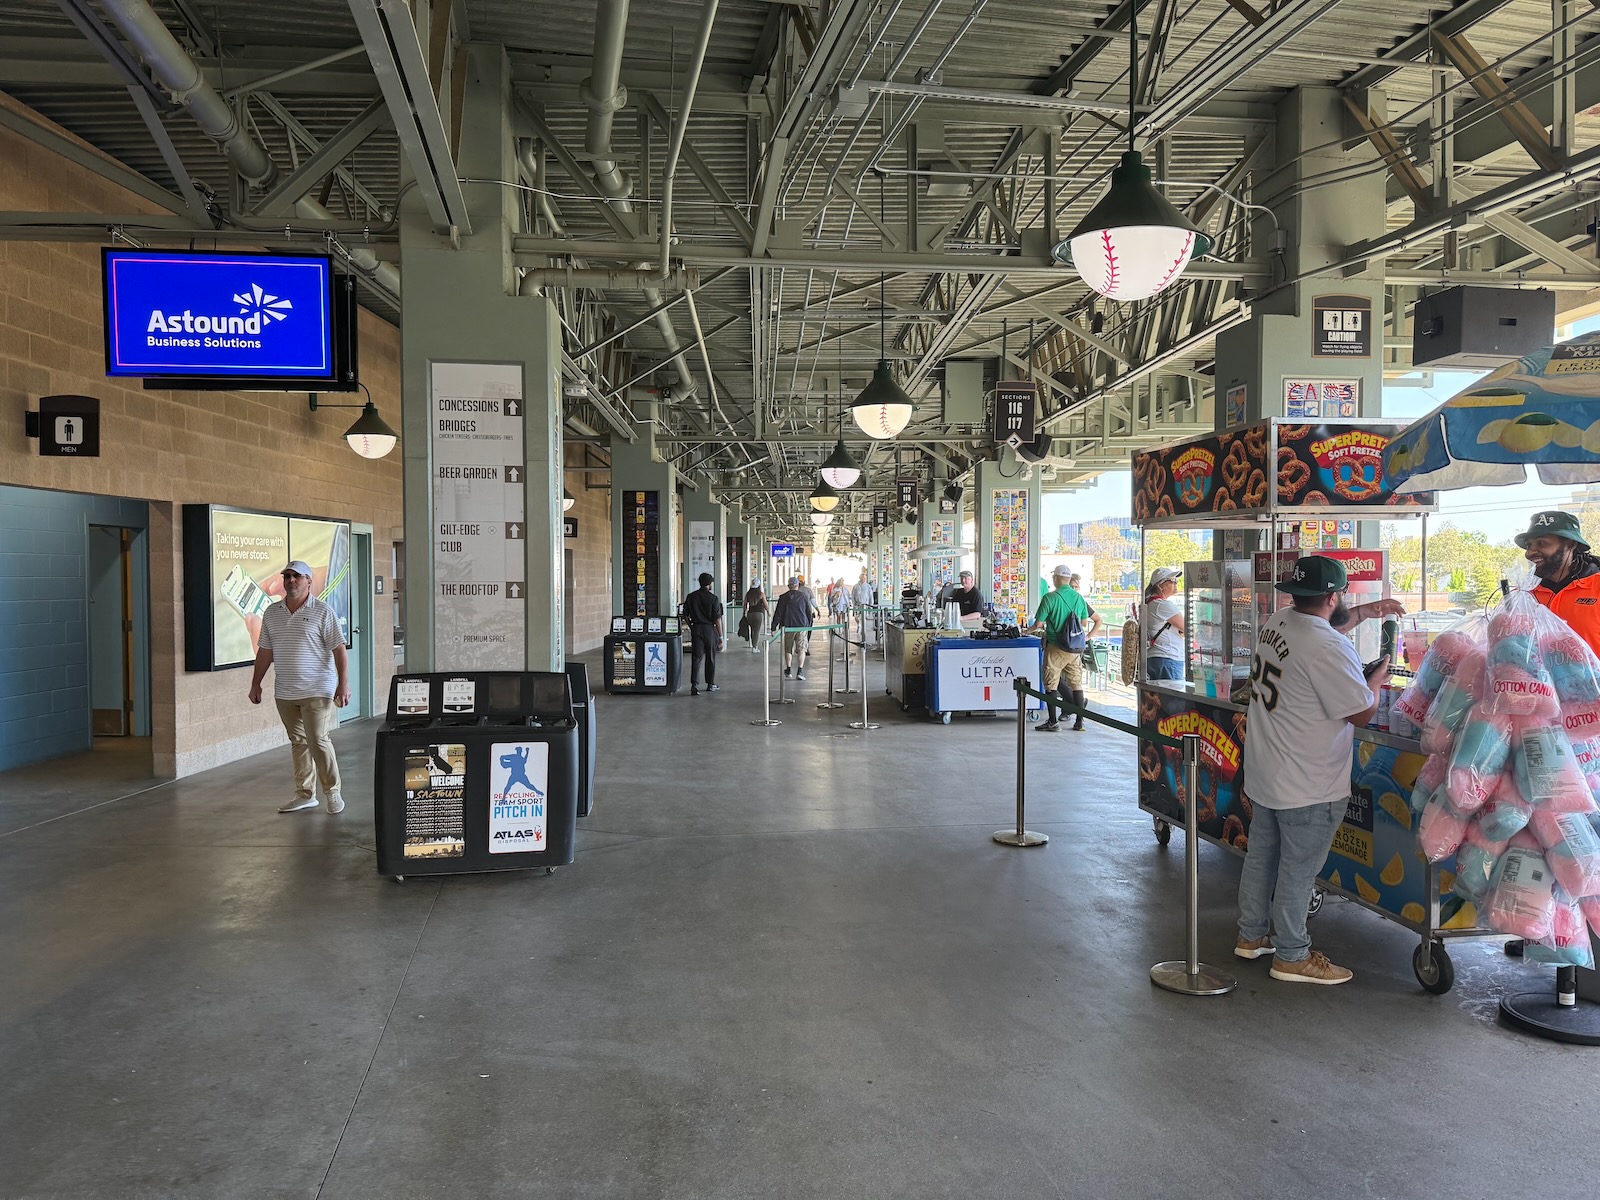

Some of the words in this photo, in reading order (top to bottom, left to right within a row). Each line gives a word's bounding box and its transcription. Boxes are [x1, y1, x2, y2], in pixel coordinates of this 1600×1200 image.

[147, 310, 261, 334] Astound
[147, 336, 201, 347] Business
[204, 337, 261, 348] Solutions
[1327, 331, 1356, 341] CAUTION!
[439, 399, 499, 412] CONCESSIONS
[1008, 402, 1023, 414] 116
[439, 420, 476, 431] BRIDGES
[1008, 417, 1022, 429] 117
[1171, 447, 1215, 473] SUPERPRETZEL
[1328, 448, 1348, 460] SOFT
[439, 467, 461, 478] BEER
[463, 468, 497, 479] GARDEN
[1179, 462, 1190, 474] SOFT
[1535, 514, 1555, 526] A's
[440, 524, 480, 535] GILT-EDGE
[216, 533, 239, 547] Taking
[240, 537, 255, 547] your
[256, 538, 269, 546] care
[271, 537, 283, 546] with
[440, 542, 462, 552] CLUB
[216, 550, 229, 561] you
[231, 550, 249, 559] never
[250, 550, 269, 561] stops.
[441, 584, 456, 595] THE
[460, 584, 499, 595] ROOFTOP
[911, 636, 926, 656] CRAFT
[969, 655, 1005, 665] Michelob
[961, 666, 1015, 679] ULTRA
[1494, 681, 1526, 694] COTTON
[1566, 712, 1598, 729] COTTON
[1158, 712, 1239, 768] SUPERPRETZEL
[431, 776, 464, 787] WELCOME
[406, 791, 414, 799] TO
[415, 789, 463, 800] SACTOWN
[494, 806, 527, 819] PITCH
[531, 805, 543, 817] IN
[1345, 806, 1363, 823] aid
[493, 829, 534, 840] ATLAS
[1343, 827, 1355, 835] SOFT
[1336, 831, 1367, 851] ROZEN
